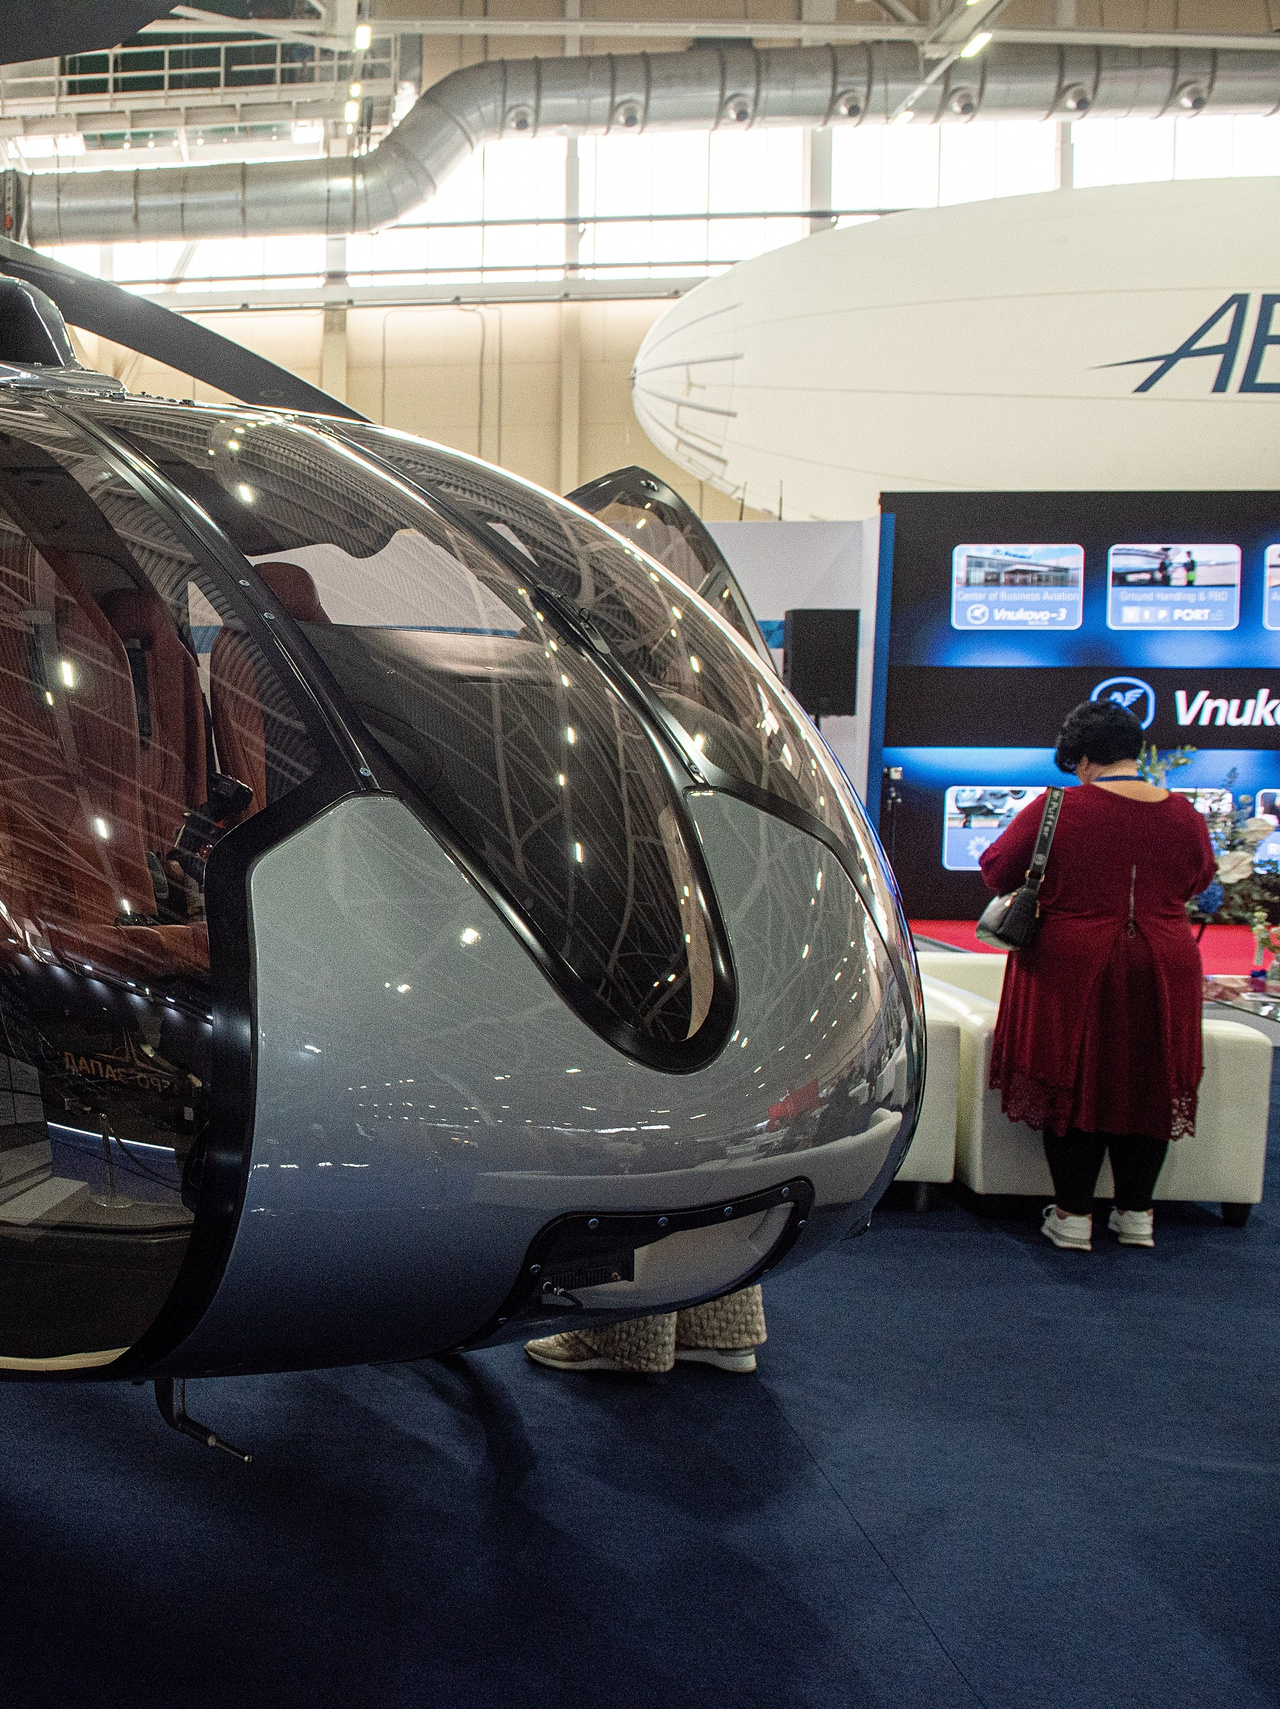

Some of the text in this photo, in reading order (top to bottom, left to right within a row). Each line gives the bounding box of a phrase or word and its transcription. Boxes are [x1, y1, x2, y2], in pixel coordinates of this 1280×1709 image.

[988, 590, 999, 601] of
[1000, 590, 1041, 601] Business
[1043, 590, 1079, 601] Aviation
[993, 607, 1068, 622] Vnukovo-3
[1173, 608, 1211, 622] PORT
[1174, 688, 1280, 727] Vnuk
